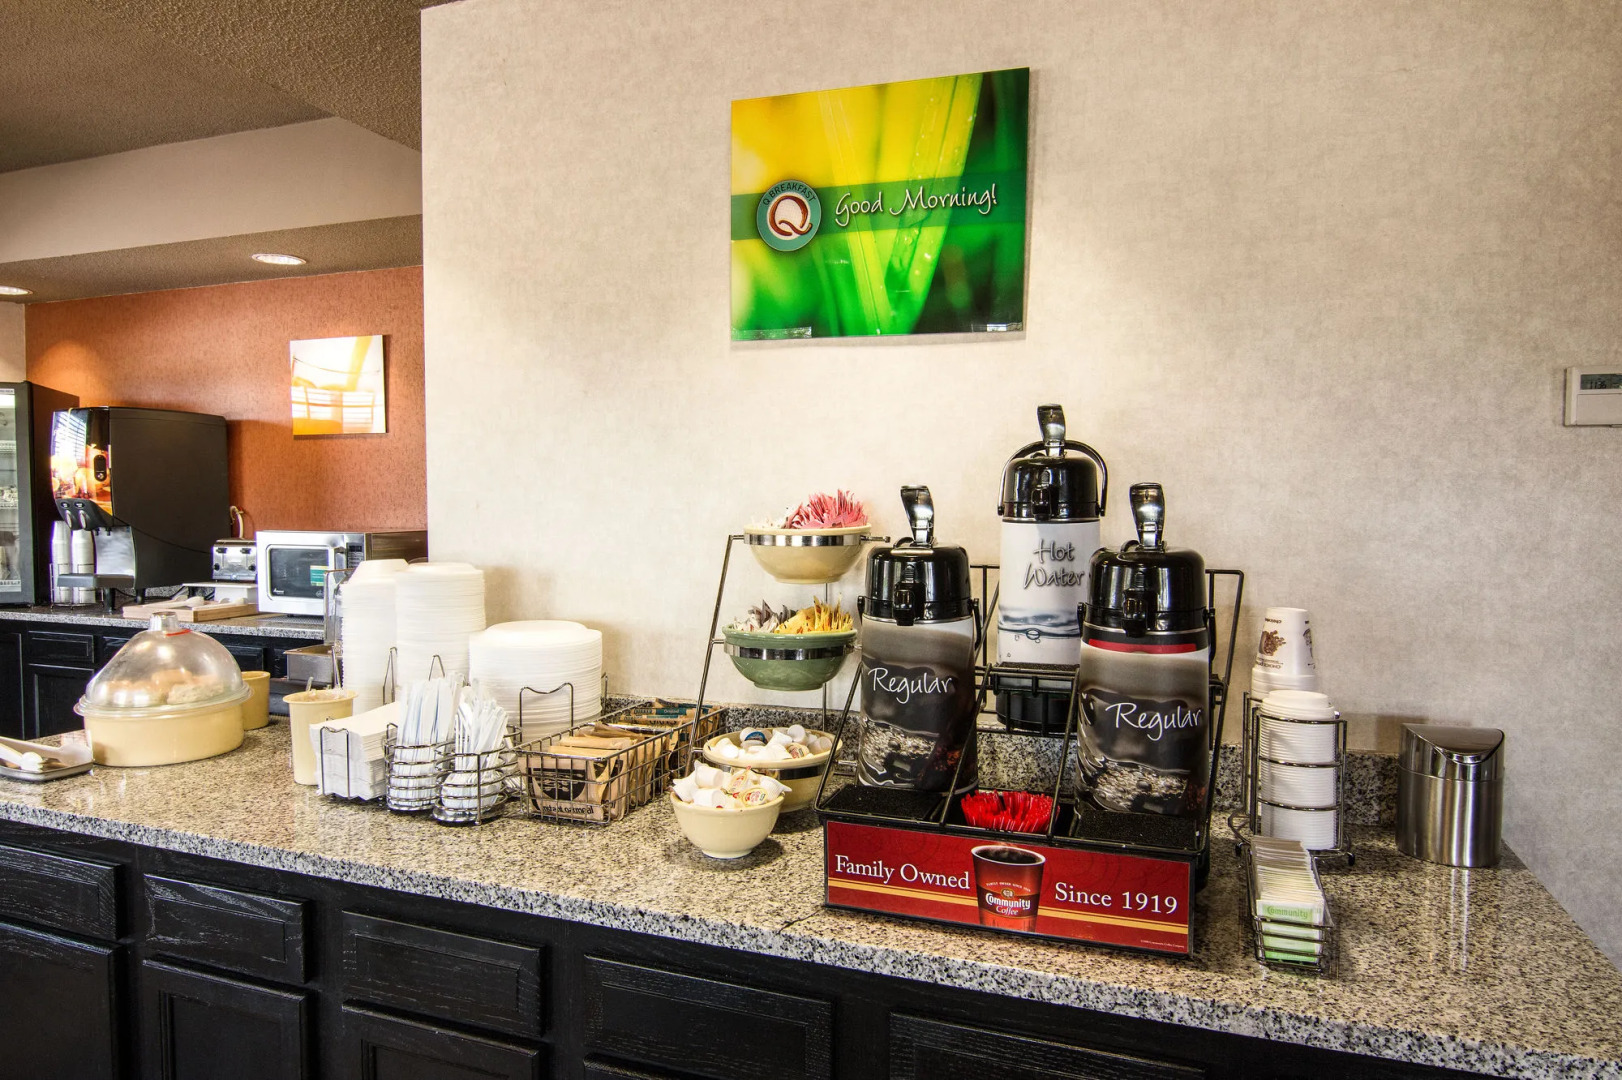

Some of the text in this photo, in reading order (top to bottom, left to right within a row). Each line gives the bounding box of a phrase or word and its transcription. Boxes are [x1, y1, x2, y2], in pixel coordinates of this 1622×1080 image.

[762, 182, 817, 206] Q BREAKFAST
[834, 183, 997, 227] Good Morning!
[768, 195, 813, 236] Q
[1033, 538, 1075, 564] Hot
[1023, 562, 1085, 590] Water
[867, 667, 953, 704] Regular
[1104, 702, 1202, 742] Regular
[834, 854, 971, 889] Family Owned
[985, 892, 1031, 910] Community
[995, 905, 1019, 916] Coffee
[1055, 881, 1178, 915] Since 1919
[1266, 905, 1309, 919] Community
